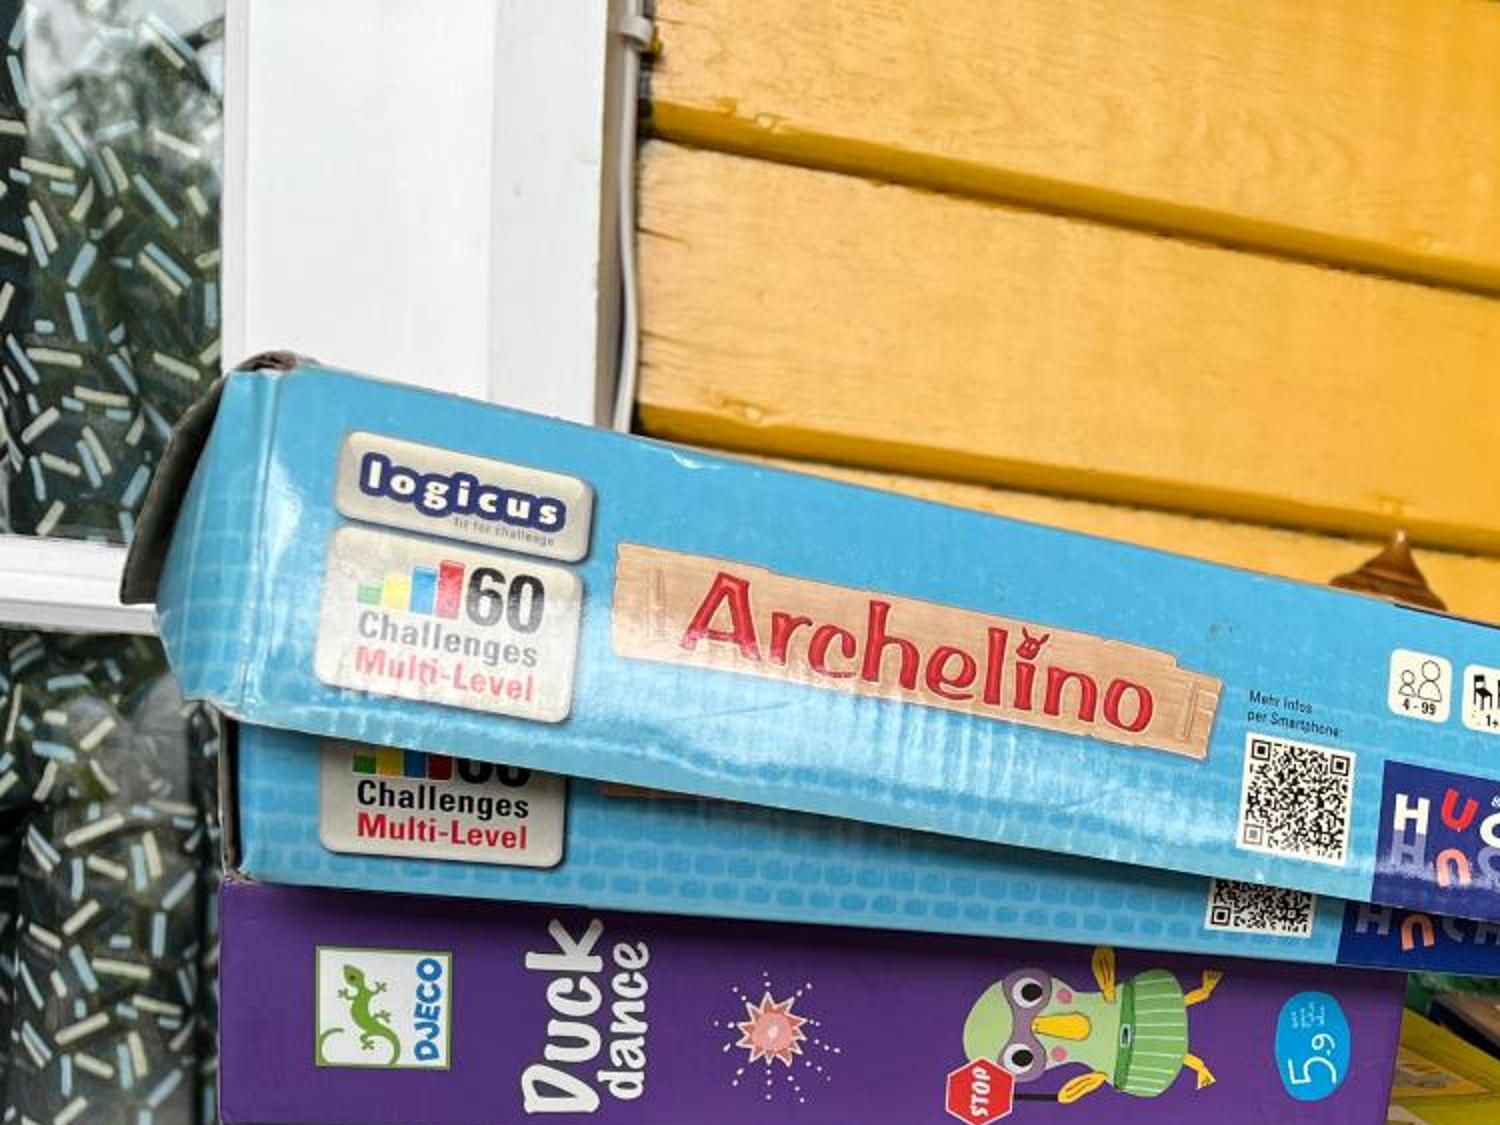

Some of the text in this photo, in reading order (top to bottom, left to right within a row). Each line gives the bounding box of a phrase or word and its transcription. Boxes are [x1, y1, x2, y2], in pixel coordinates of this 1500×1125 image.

[359, 452, 567, 533] logicus
[466, 567, 546, 634] 60
[357, 610, 538, 668] Challenges
[680, 571, 1154, 734] Archelino
[354, 645, 536, 703] Multi-Level
[356, 812, 527, 850] Multi-Level
[357, 780, 529, 820] Challenges
[414, 957, 443, 1062] DJECO
[520, 918, 604, 1115] Duck
[598, 940, 650, 1100] dance
[971, 1067, 991, 1118] STOP
